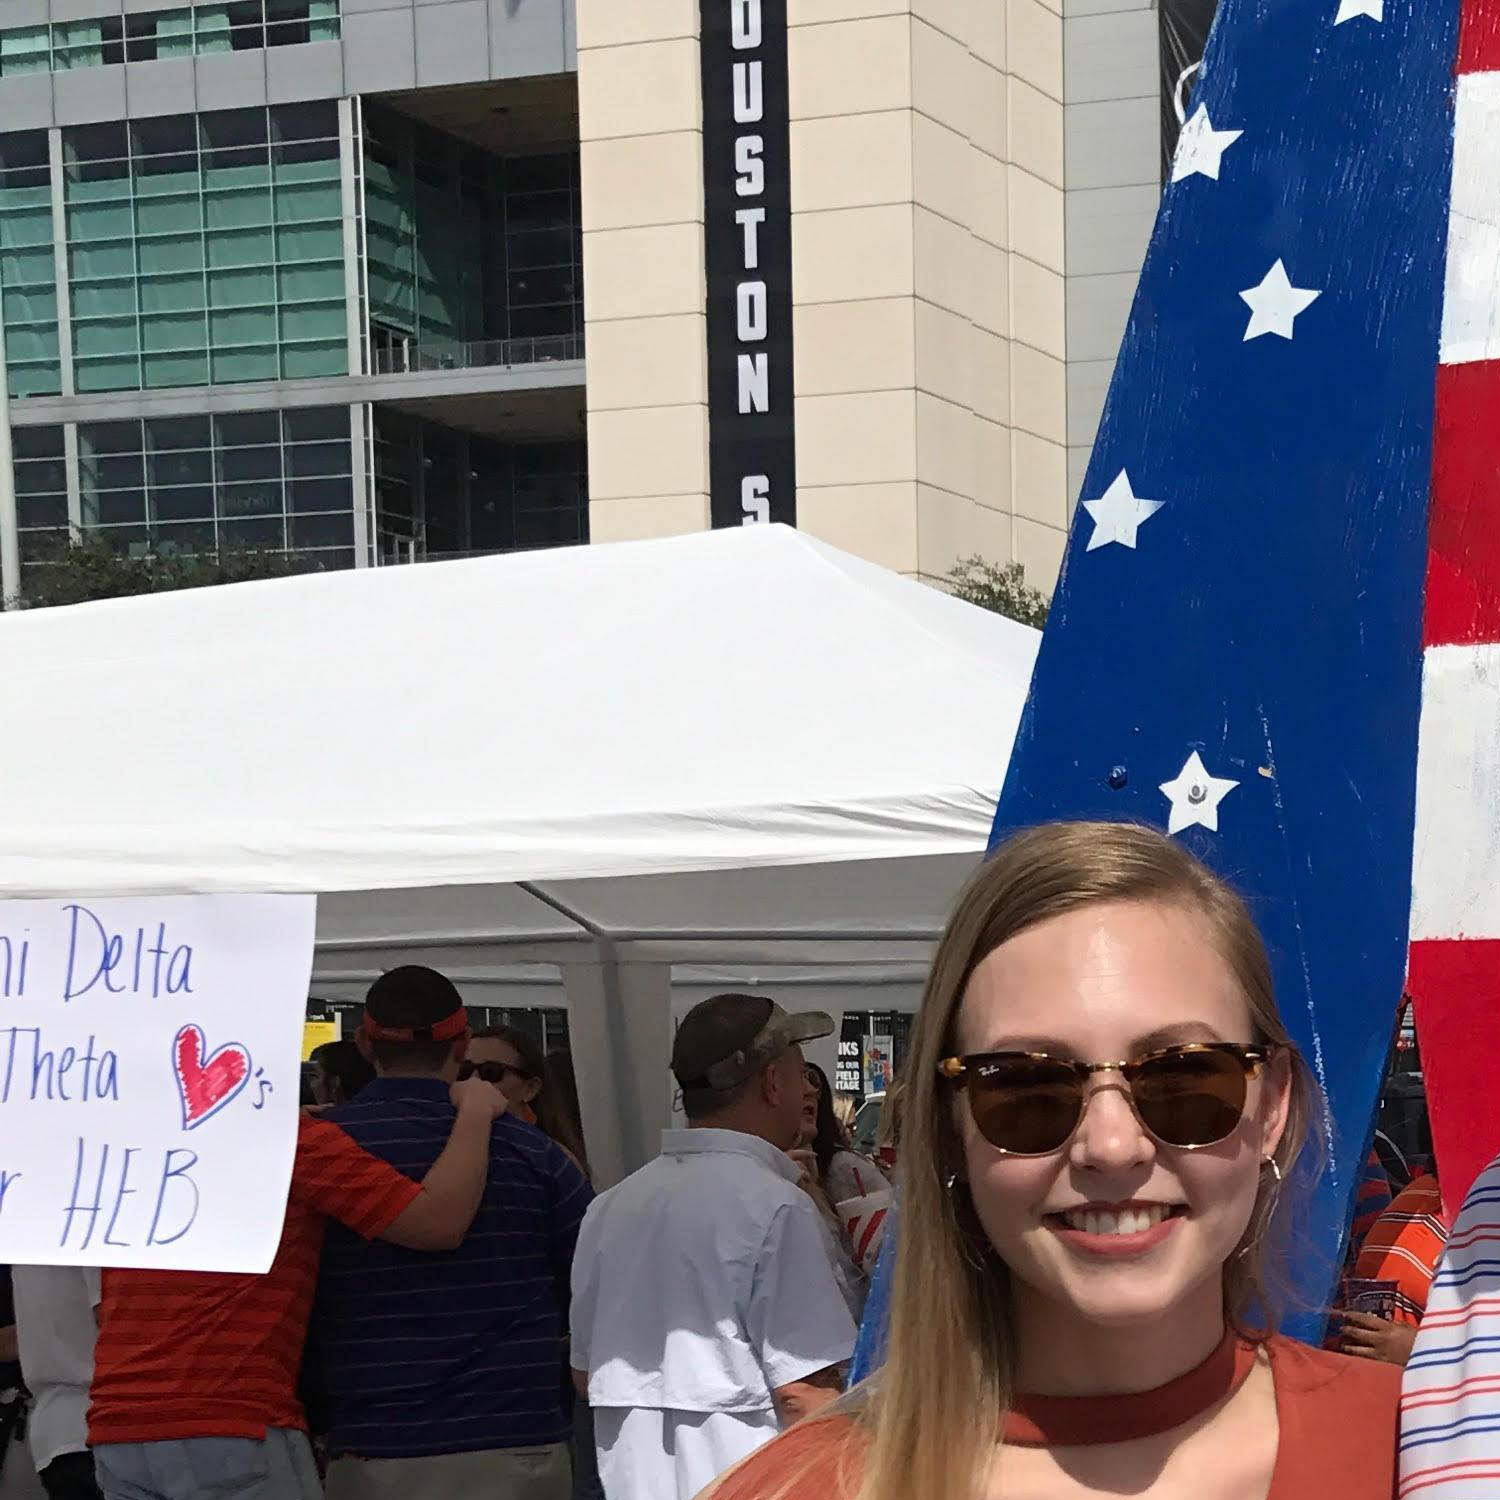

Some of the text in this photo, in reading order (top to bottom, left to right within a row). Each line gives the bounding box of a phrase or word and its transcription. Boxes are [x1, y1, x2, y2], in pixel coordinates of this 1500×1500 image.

[62, 905, 194, 1002] Delta
[0, 1027, 119, 1101] Theta
[60, 1137, 199, 1249] HEB
